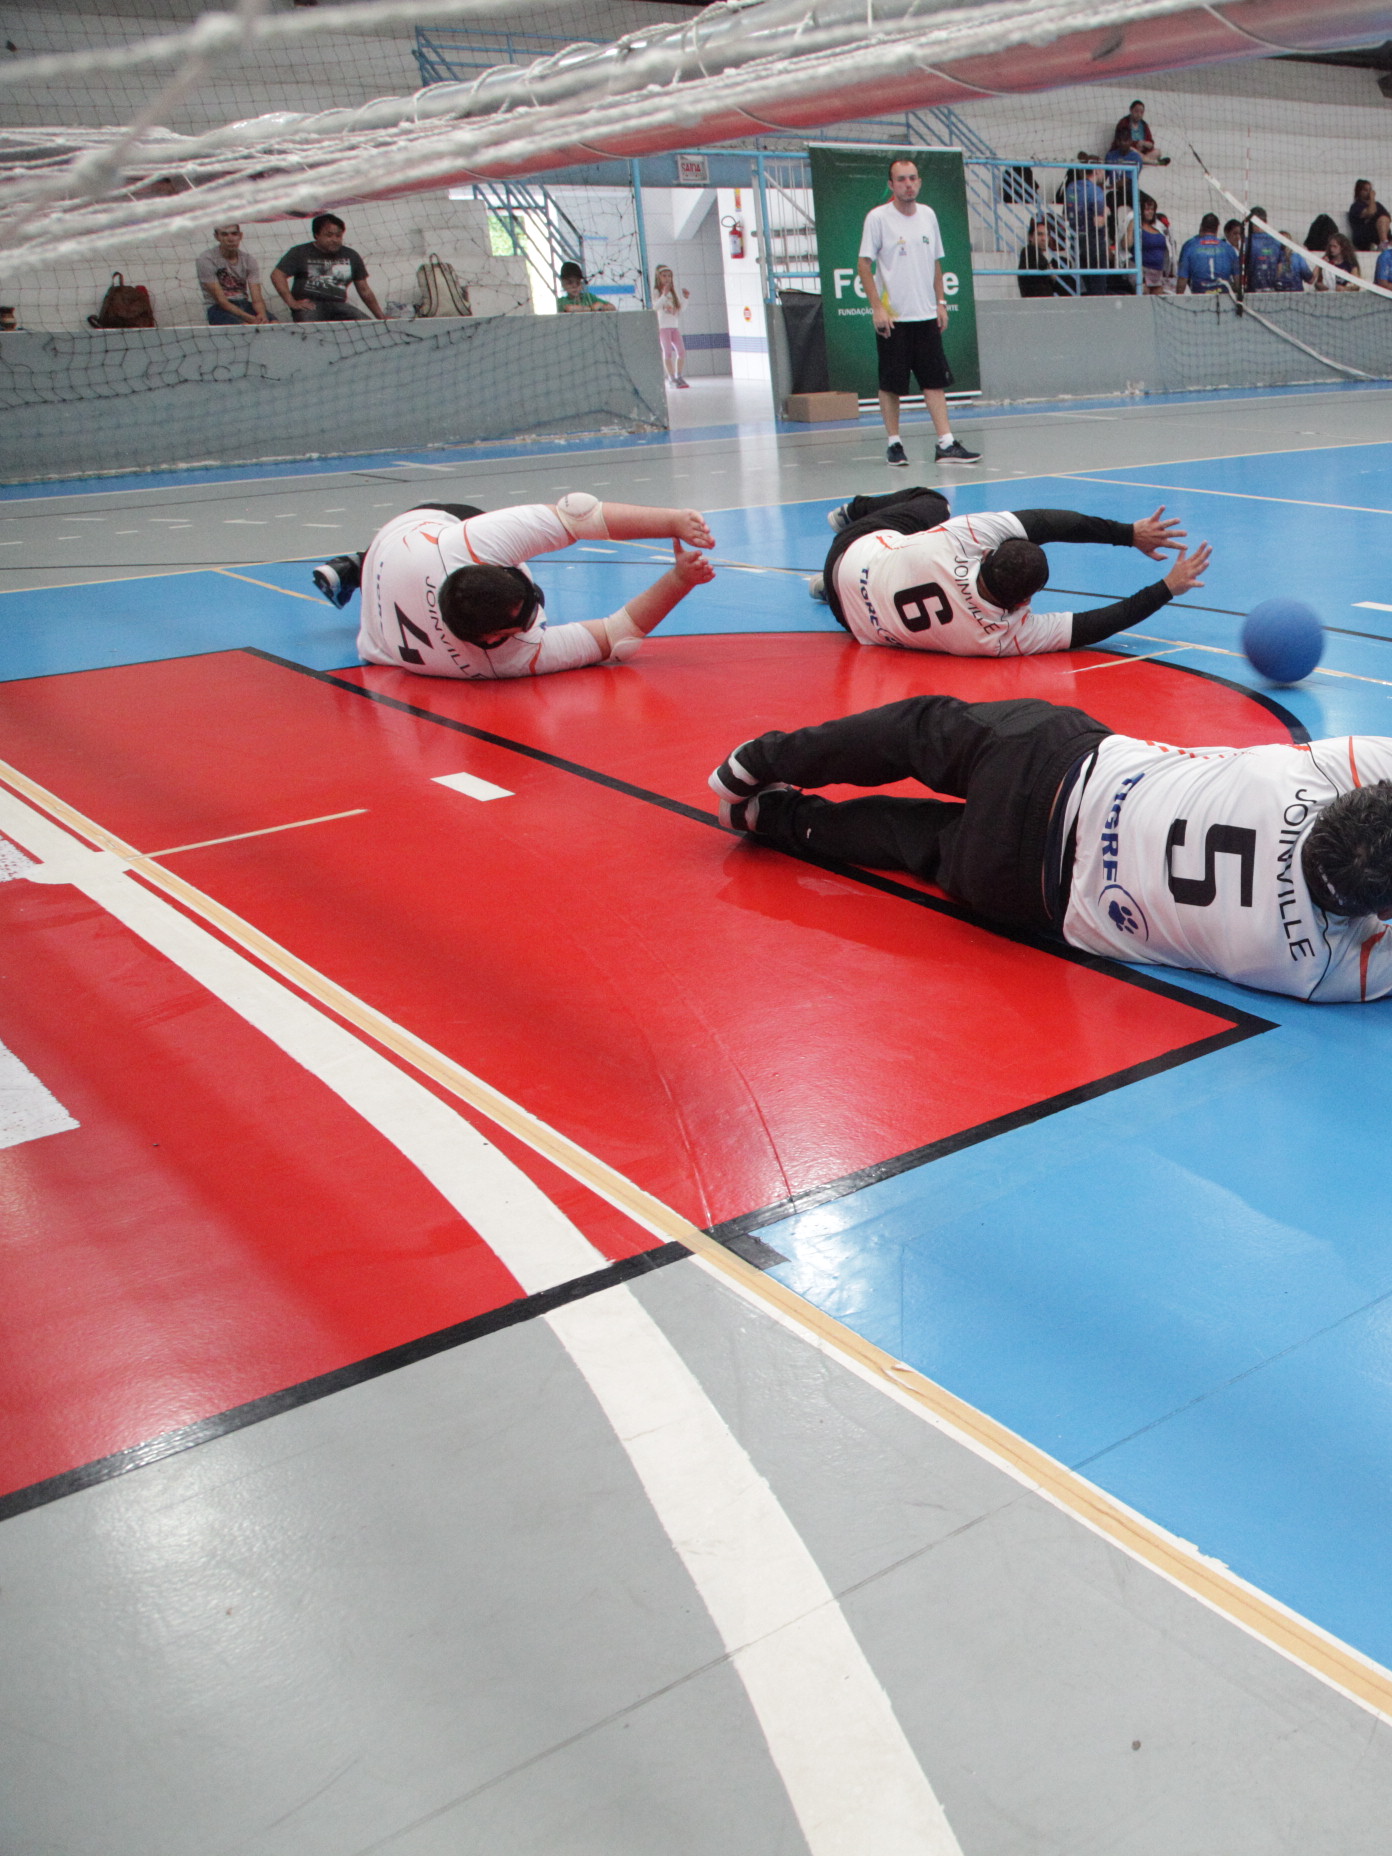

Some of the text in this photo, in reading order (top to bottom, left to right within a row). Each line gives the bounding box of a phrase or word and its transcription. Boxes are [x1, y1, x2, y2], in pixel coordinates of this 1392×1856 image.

[838, 307, 874, 316] FUNDAÇÃO
[860, 567, 879, 627] TIGRE
[893, 582, 953, 633] 6
[954, 556, 999, 635] JOINVILLE
[394, 602, 434, 665] 7
[1166, 818, 1256, 908] 5
[1277, 789, 1317, 961] JOINVILLE
